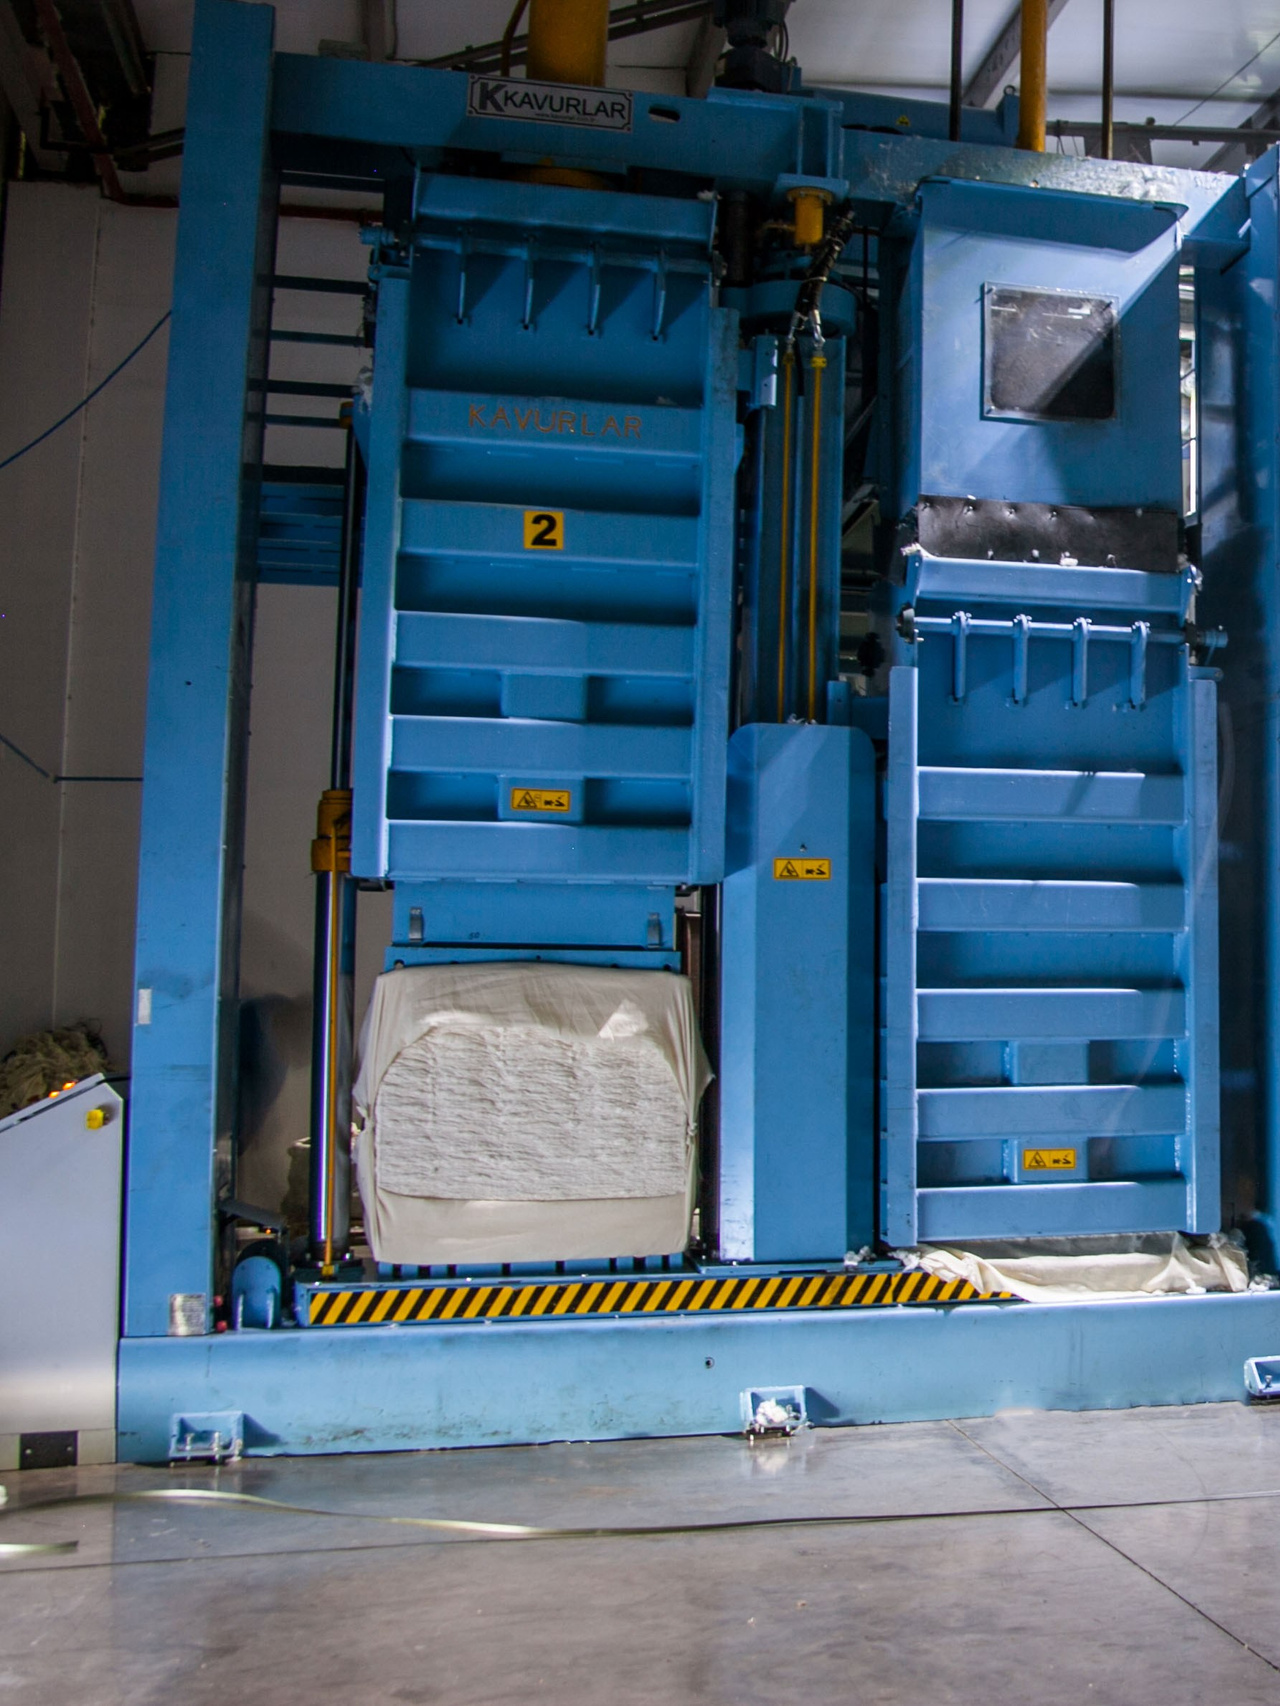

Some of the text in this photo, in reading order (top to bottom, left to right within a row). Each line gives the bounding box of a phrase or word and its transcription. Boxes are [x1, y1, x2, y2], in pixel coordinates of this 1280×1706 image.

[479, 81, 626, 120] K KAVURLAR
[469, 403, 642, 439] KAVURLAR
[531, 514, 557, 547] 2
